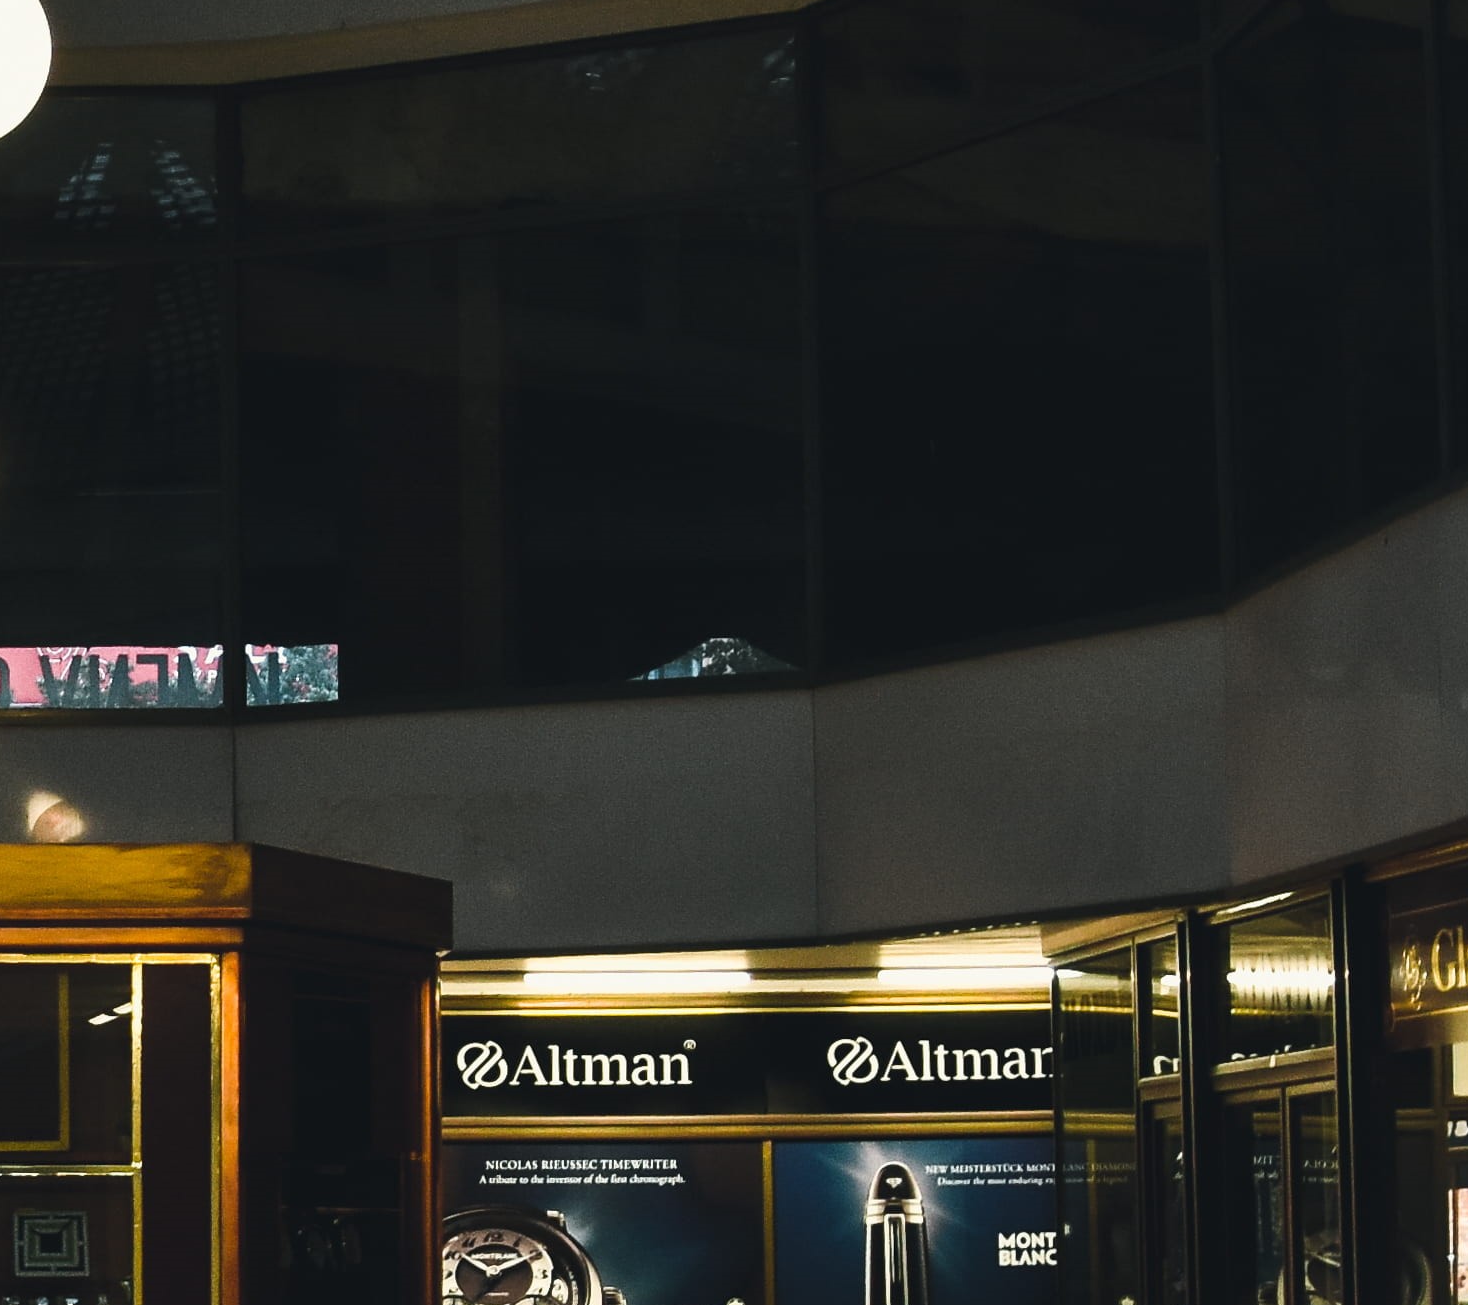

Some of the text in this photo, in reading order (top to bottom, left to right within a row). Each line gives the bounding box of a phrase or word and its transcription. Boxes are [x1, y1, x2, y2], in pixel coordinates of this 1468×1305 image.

[485, 1158, 678, 1171] NICOLAS RIEUSSEC TIMEWRITER
[925, 1164, 948, 1175] NEW
[950, 1163, 1024, 1174] MEISTERSTÜCK
[478, 1174, 487, 1185] A
[488, 1173, 517, 1185] tribute
[519, 1174, 529, 1185] to
[530, 1174, 544, 1185] the
[546, 1174, 582, 1185] inventor
[583, 1173, 593, 1185] of
[595, 1173, 609, 1185] the
[629, 1173, 686, 1187] chronograph.
[937, 1177, 971, 1186] Discover
[973, 1177, 986, 1185] the
[1008, 1177, 1044, 1187] enduring
[998, 1231, 1057, 1249] MONT
[998, 1248, 1058, 1267] BLANC
